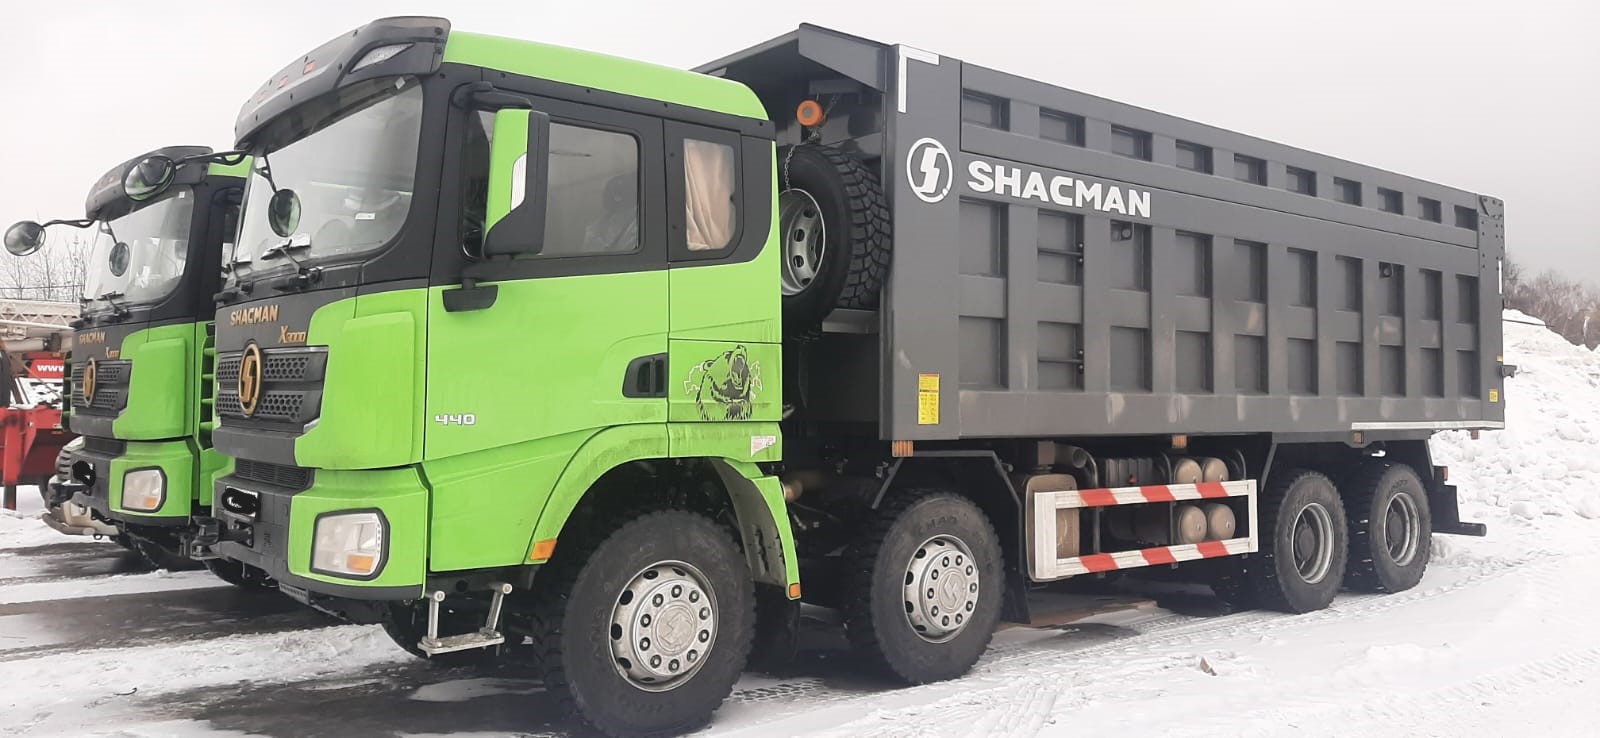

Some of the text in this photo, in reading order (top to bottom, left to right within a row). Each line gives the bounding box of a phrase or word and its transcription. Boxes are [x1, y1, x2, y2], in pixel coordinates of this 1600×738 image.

[968, 161, 1150, 217] SHACMAN
[230, 305, 278, 325] SHACMAN
[435, 414, 475, 425] 440
